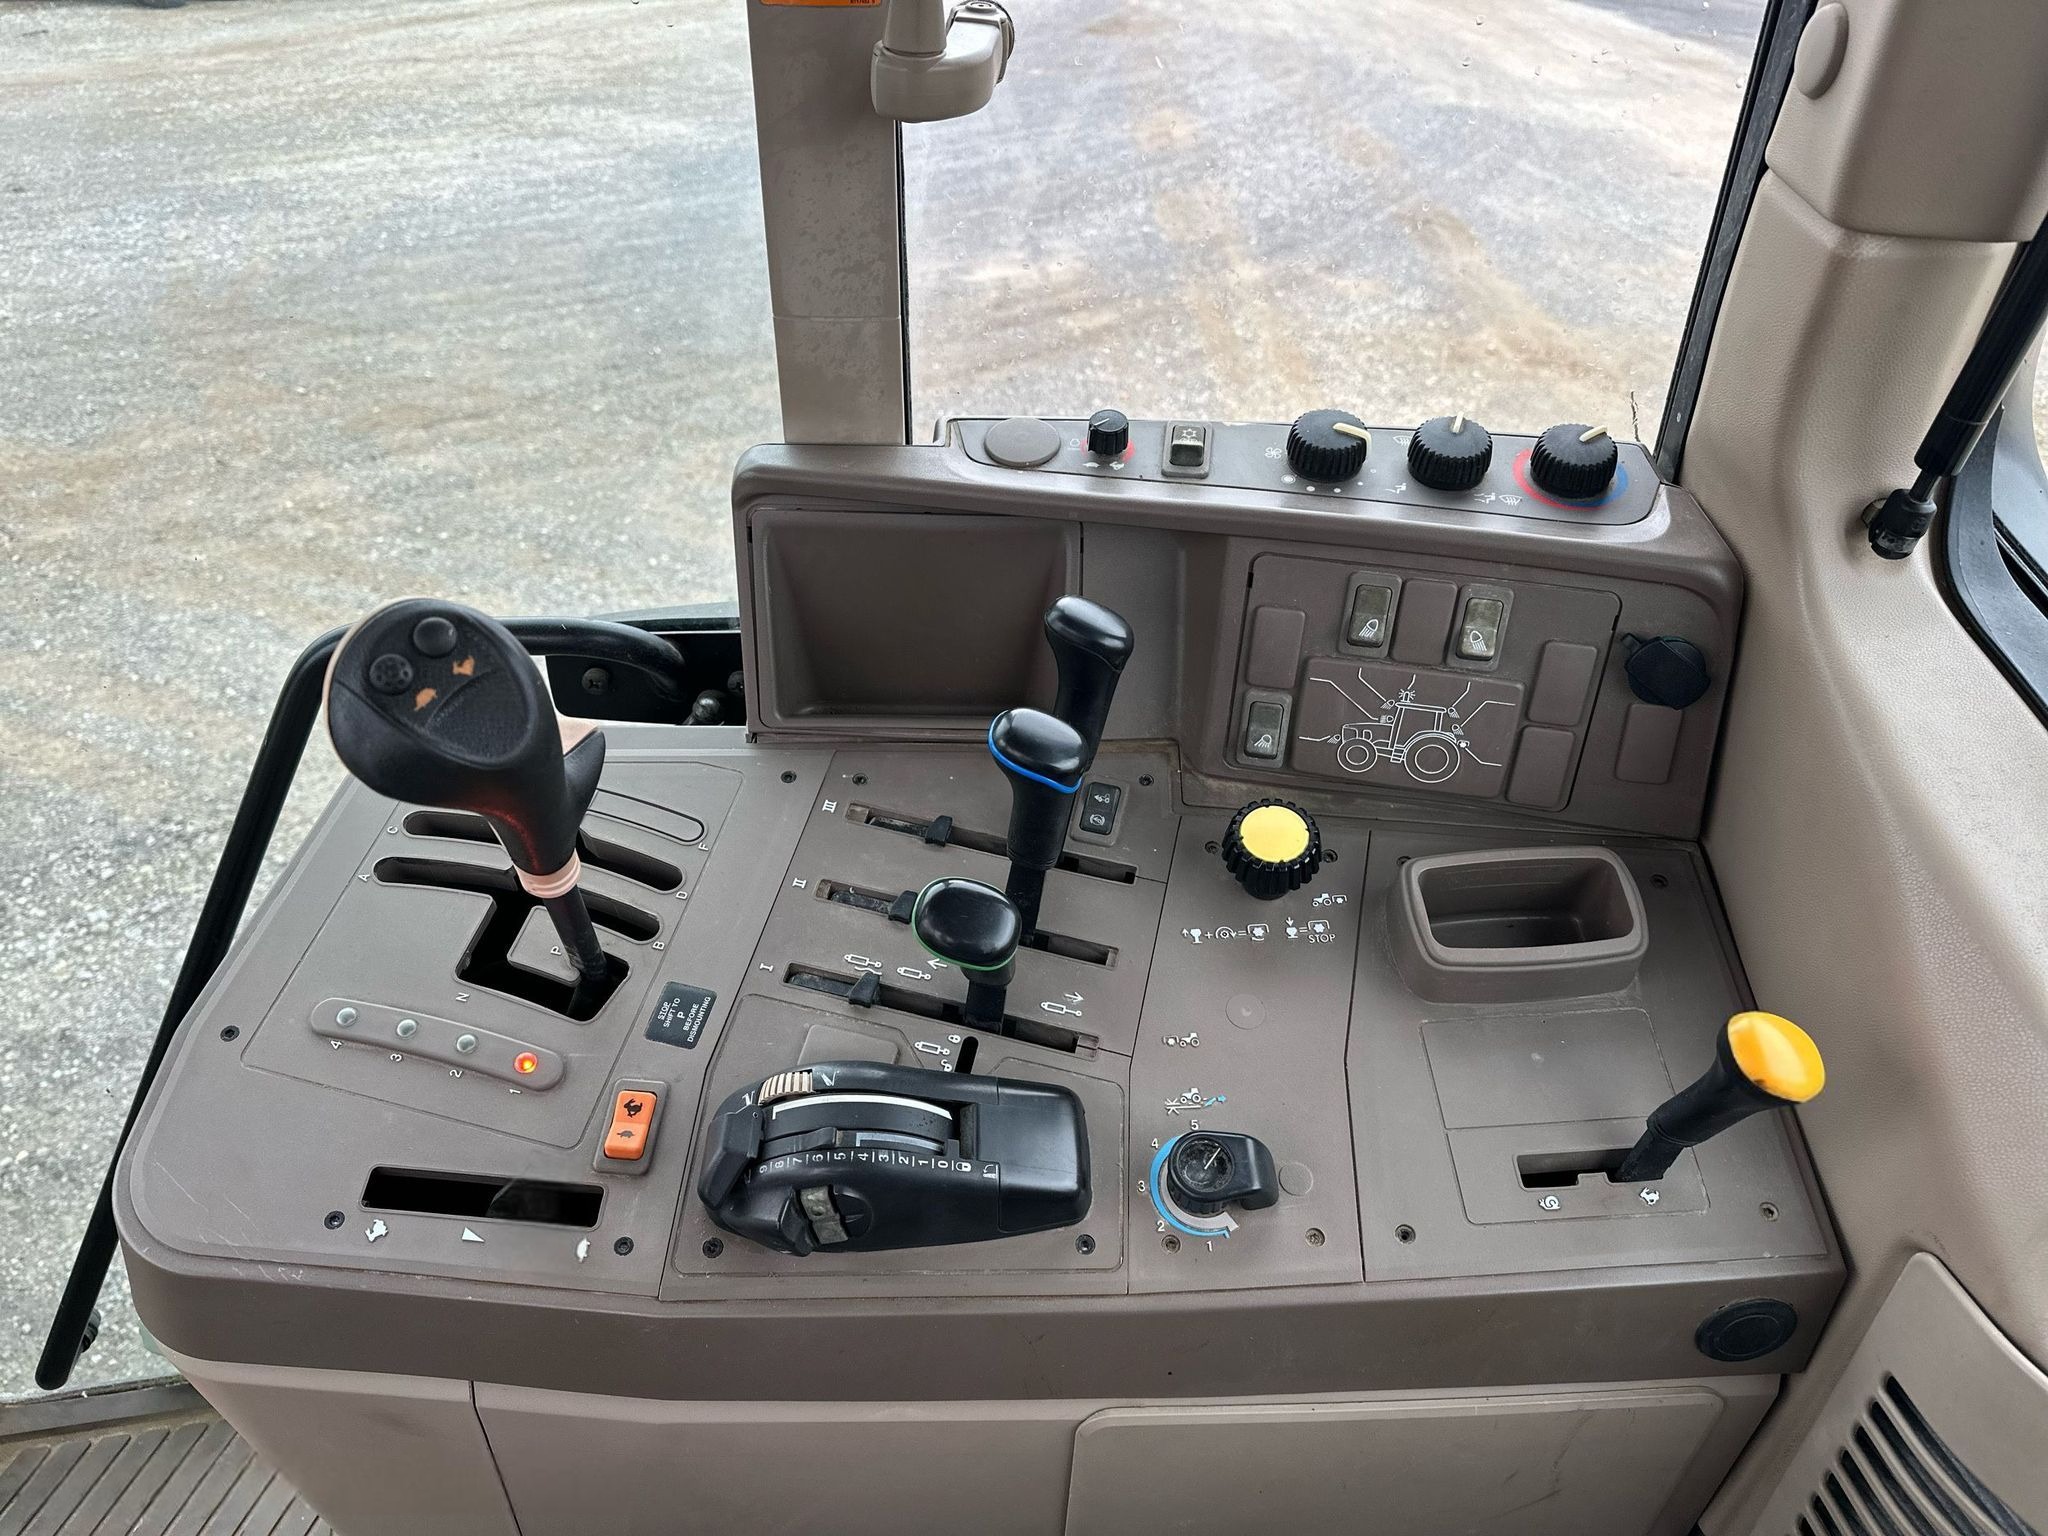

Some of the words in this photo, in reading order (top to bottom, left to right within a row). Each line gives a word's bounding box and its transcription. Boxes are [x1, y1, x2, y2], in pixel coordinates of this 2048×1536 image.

[822, 800, 837, 813] III
[387, 825, 398, 835] C
[698, 842, 709, 852] F
[358, 872, 371, 882] A
[792, 878, 806, 889] II
[676, 890, 688, 900] D
[1308, 932, 1336, 944] STOP
[550, 946, 562, 956] P
[653, 941, 665, 951] B
[456, 993, 470, 1003] N
[657, 1001, 671, 1020] STOP
[663, 1008, 676, 1028] SHIFT
[671, 997, 681, 1009] TO
[677, 1011, 685, 1019] P
[683, 1003, 700, 1031] BEFORE
[687, 996, 711, 1043] DISMOUNTING
[330, 1040, 342, 1050] 4
[391, 1053, 403, 1063] 3
[449, 1068, 463, 1079] 2
[1190, 1119, 1199, 1131] 5
[1151, 1138, 1159, 1149] 4
[759, 1165, 768, 1174] 9
[775, 1160, 784, 1169] 8
[793, 1157, 803, 1165] 7
[813, 1153, 823, 1162] 6
[834, 1151, 847, 1161] 5
[857, 1152, 869, 1161] 4
[878, 1153, 889, 1162] 3
[899, 1156, 909, 1165] 2
[937, 1160, 949, 1168] 0
[1138, 1180, 1146, 1192] 3
[1157, 1221, 1165, 1232] 2
[1206, 1241, 1213, 1252] 1
